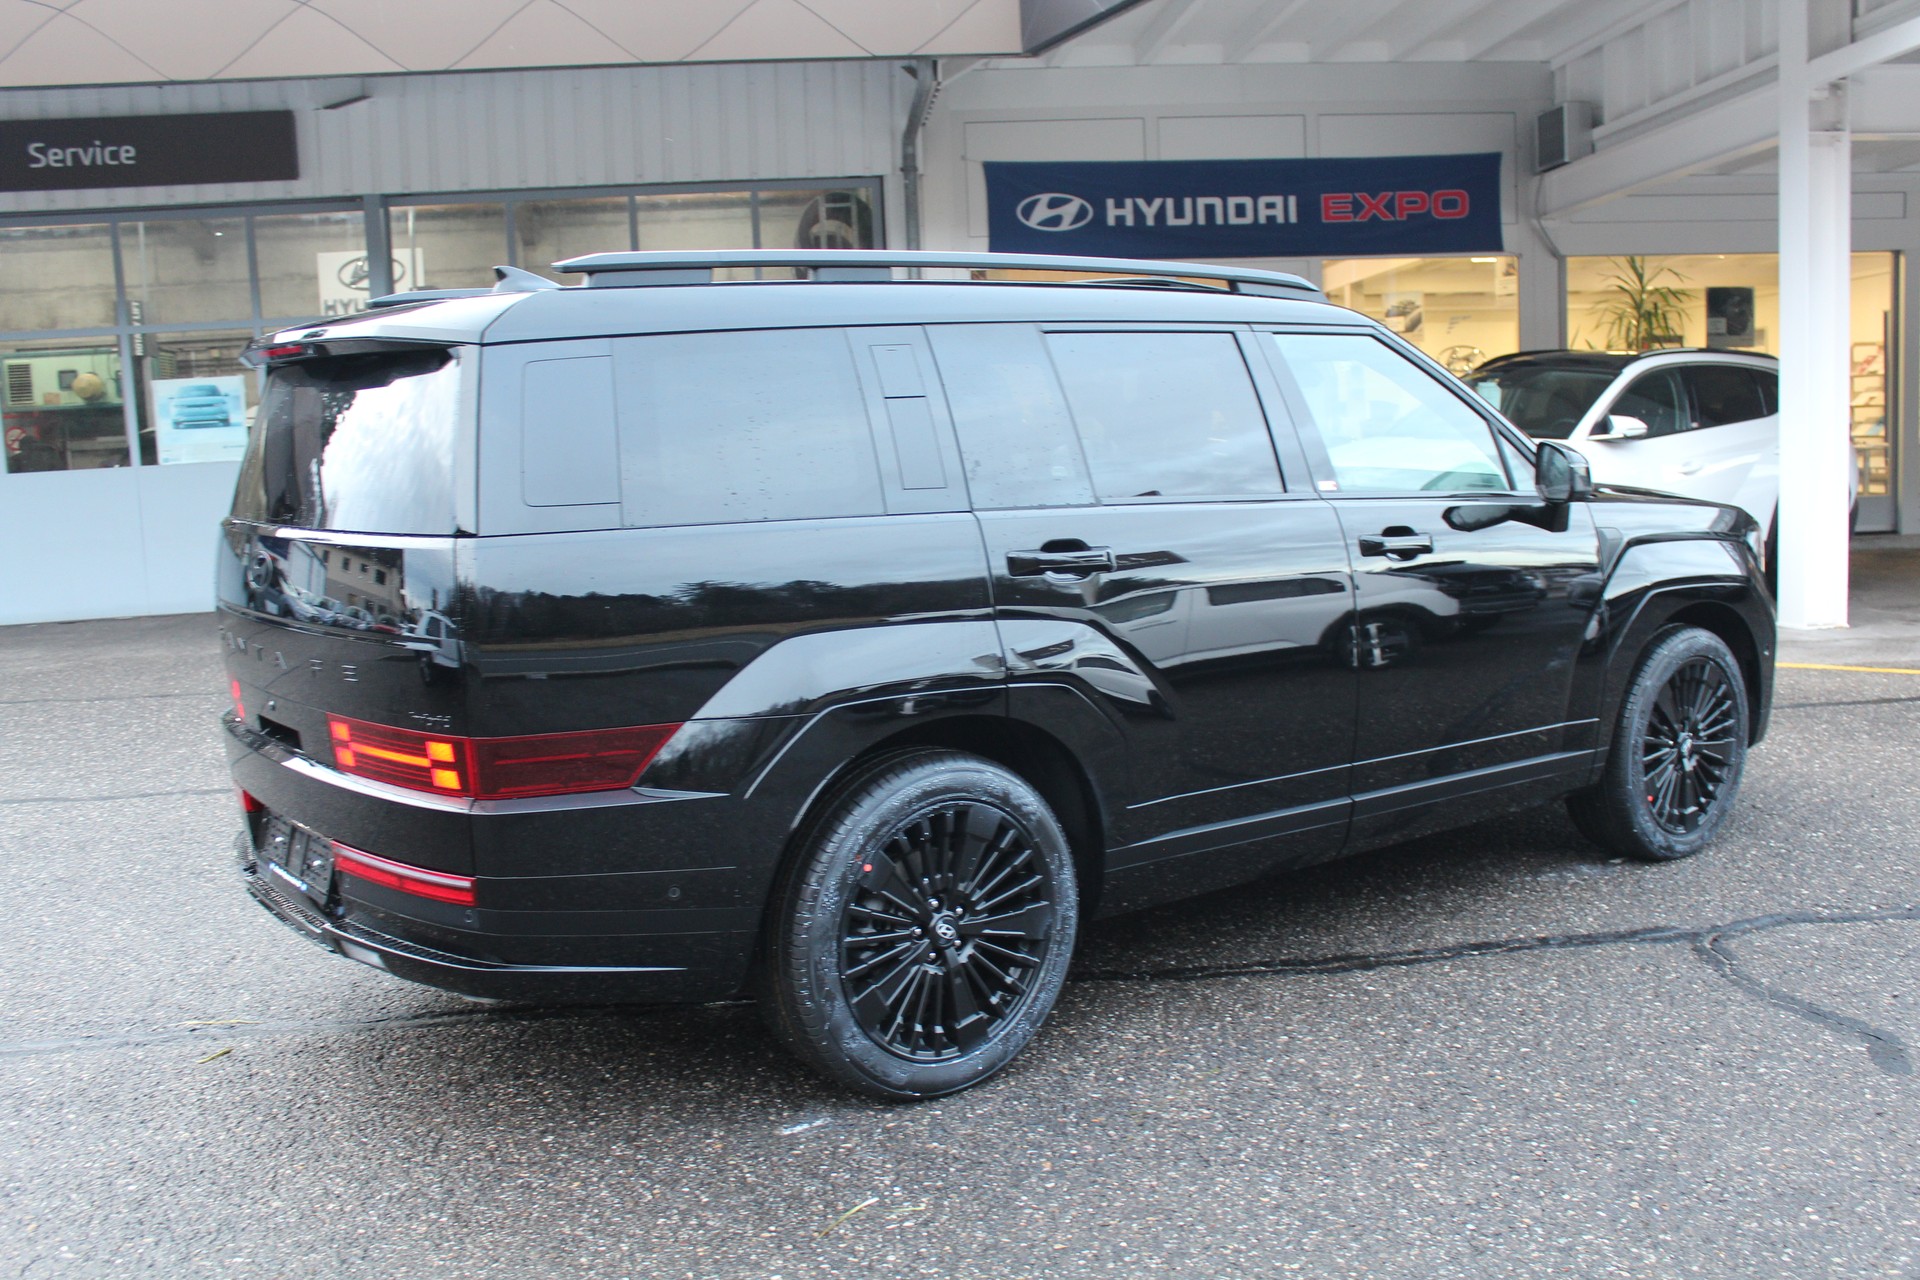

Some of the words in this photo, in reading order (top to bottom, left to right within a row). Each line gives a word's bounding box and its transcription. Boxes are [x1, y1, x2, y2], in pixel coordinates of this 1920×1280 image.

[27, 140, 136, 168] Service
[1105, 195, 1298, 227] HYUNDAI
[1320, 189, 1470, 223] EXPO
